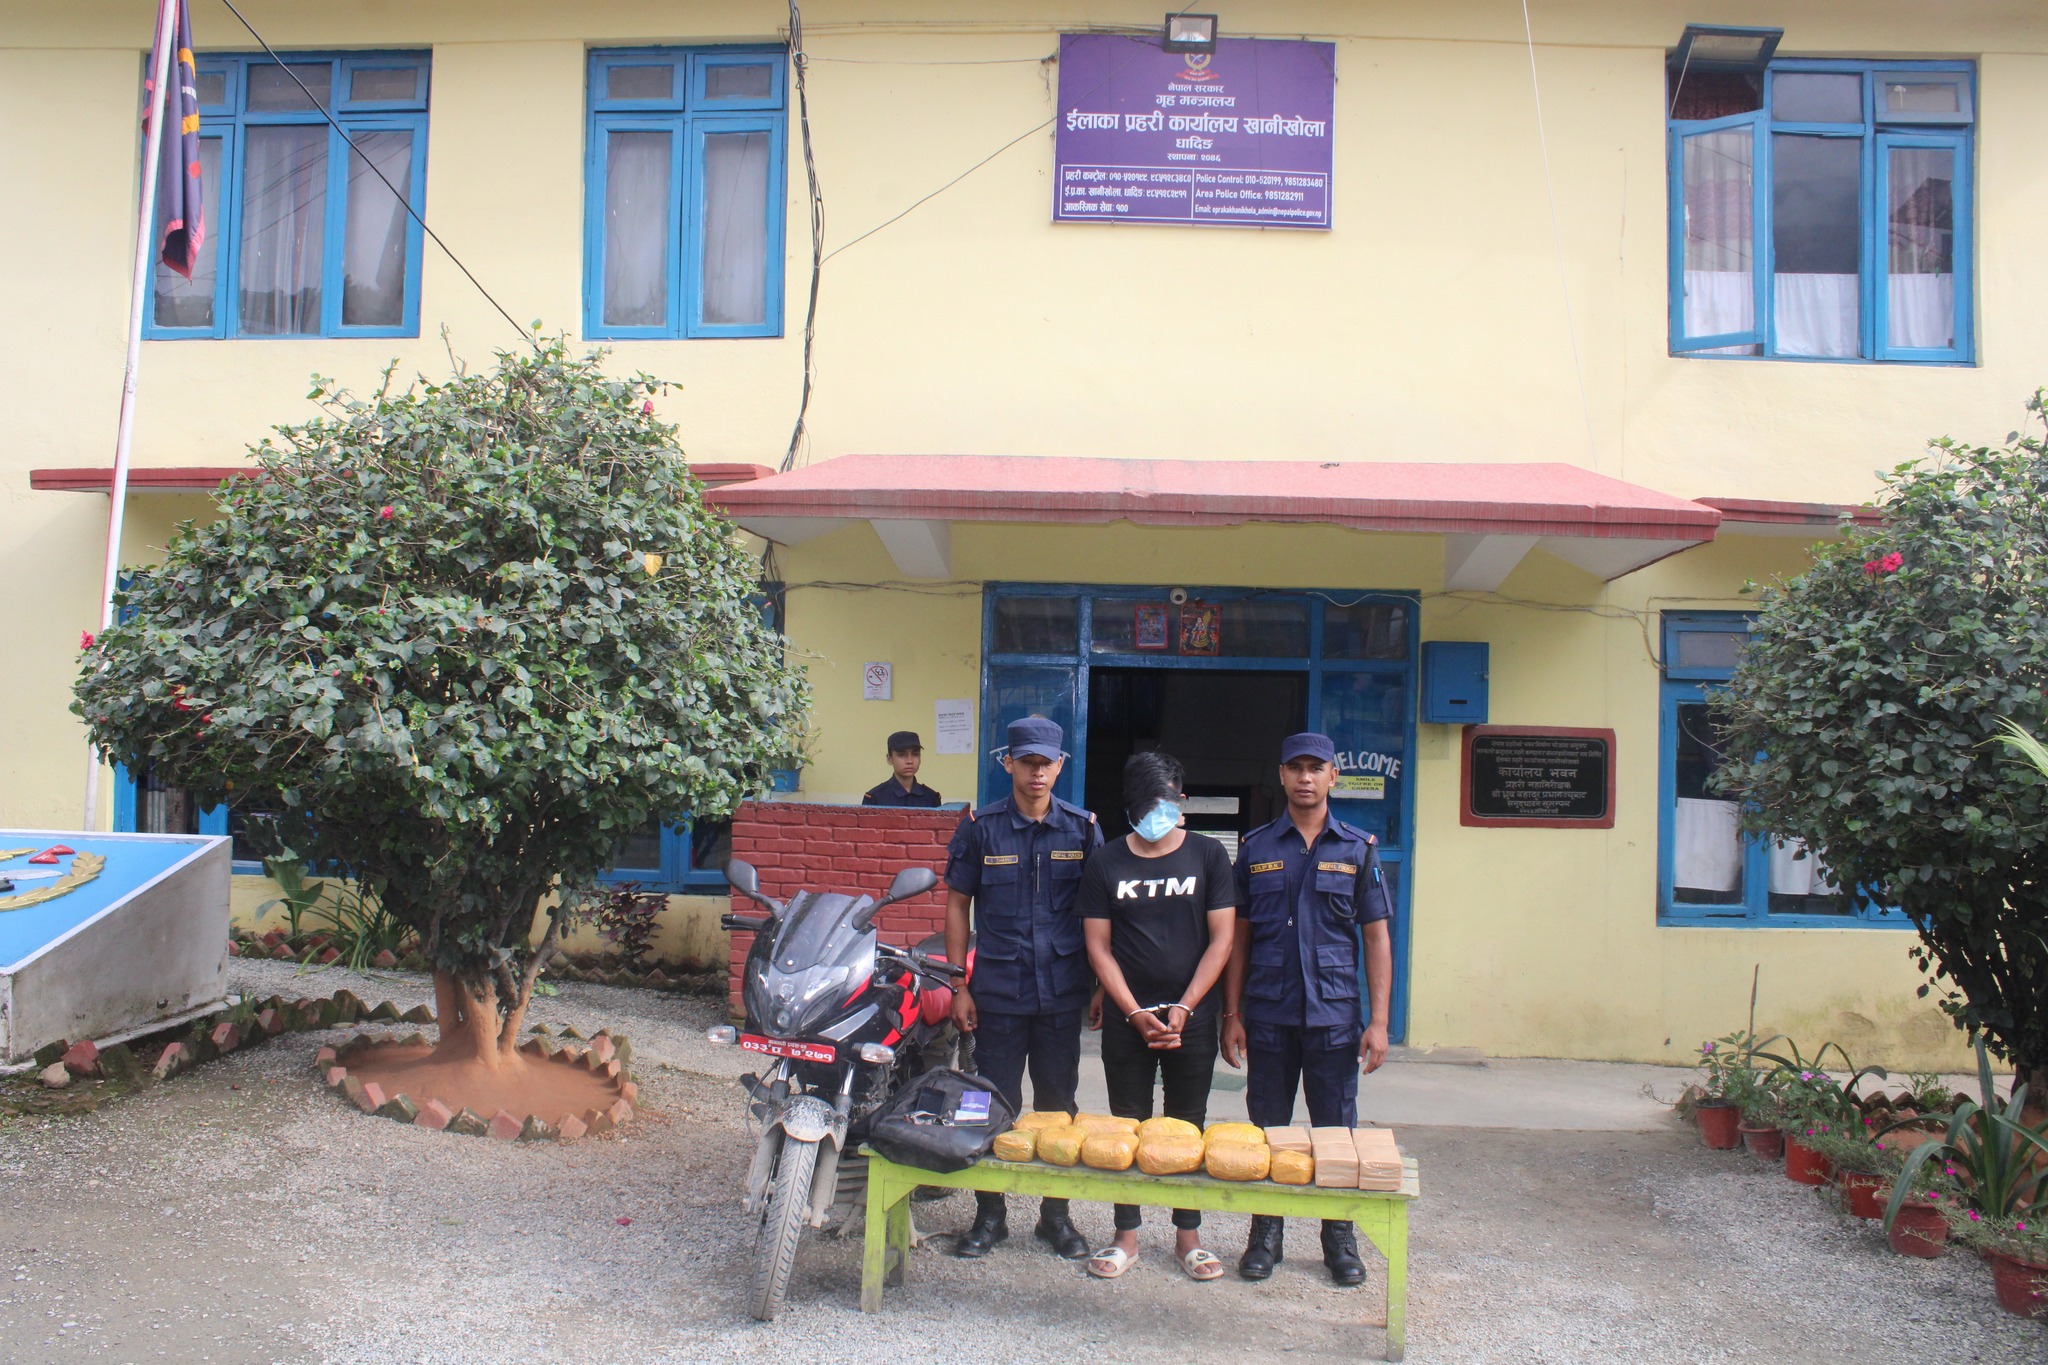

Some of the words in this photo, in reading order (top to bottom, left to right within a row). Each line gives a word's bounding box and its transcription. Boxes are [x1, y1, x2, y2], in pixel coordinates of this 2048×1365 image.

[1168, 82, 1192, 93] नेपाल
[1194, 84, 1224, 94] सरकार
[1156, 94, 1175, 108] गृह
[1180, 95, 1235, 107] मन्त्रालय
[1066, 108, 1120, 132] ईलाका
[1124, 109, 1164, 132] प्रहरी
[1168, 112, 1238, 133] कार्यालय
[1243, 114, 1326, 137] खानीखोला
[1175, 136, 1213, 149] धादिङ
[1195, 173, 1216, 184] Police
[1217, 174, 1244, 184] Control:
[1284, 178, 1323, 188] 9851283480
[1195, 188, 1214, 198] Area
[1215, 189, 1238, 199] Police
[1239, 190, 1263, 200] Office:
[1264, 191, 1304, 201] 9851282911
[1195, 204, 1211, 213] Email:
[1498, 765, 1543, 778] कार्यालय
[1549, 768, 1578, 778] भवन
[1505, 780, 1525, 789] प्रहरी
[1117, 876, 1197, 899] KTM
